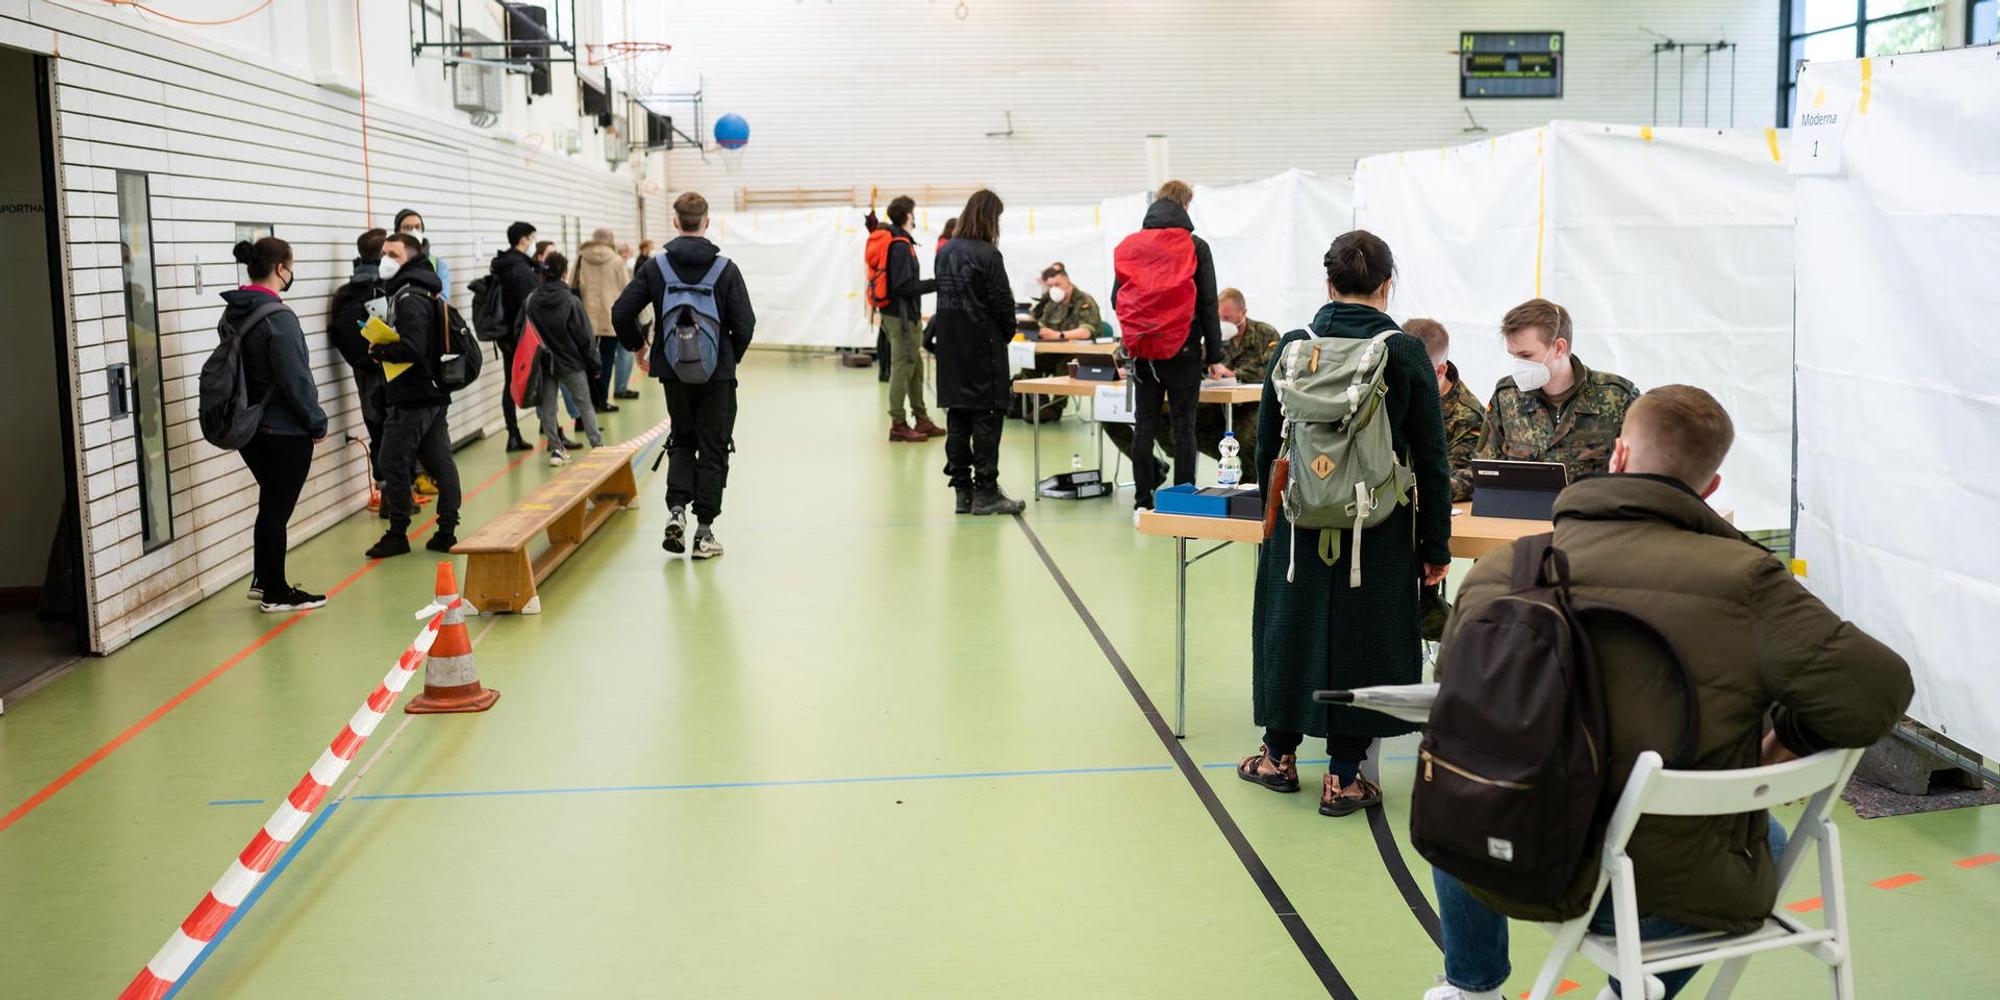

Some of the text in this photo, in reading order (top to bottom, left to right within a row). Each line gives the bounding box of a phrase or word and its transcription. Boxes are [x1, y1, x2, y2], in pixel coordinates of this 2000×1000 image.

[1463, 35, 1474, 52] H
[1549, 35, 1560, 52] G
[1801, 113, 1838, 127] Moderna
[0, 204, 44, 214] PORTHA
